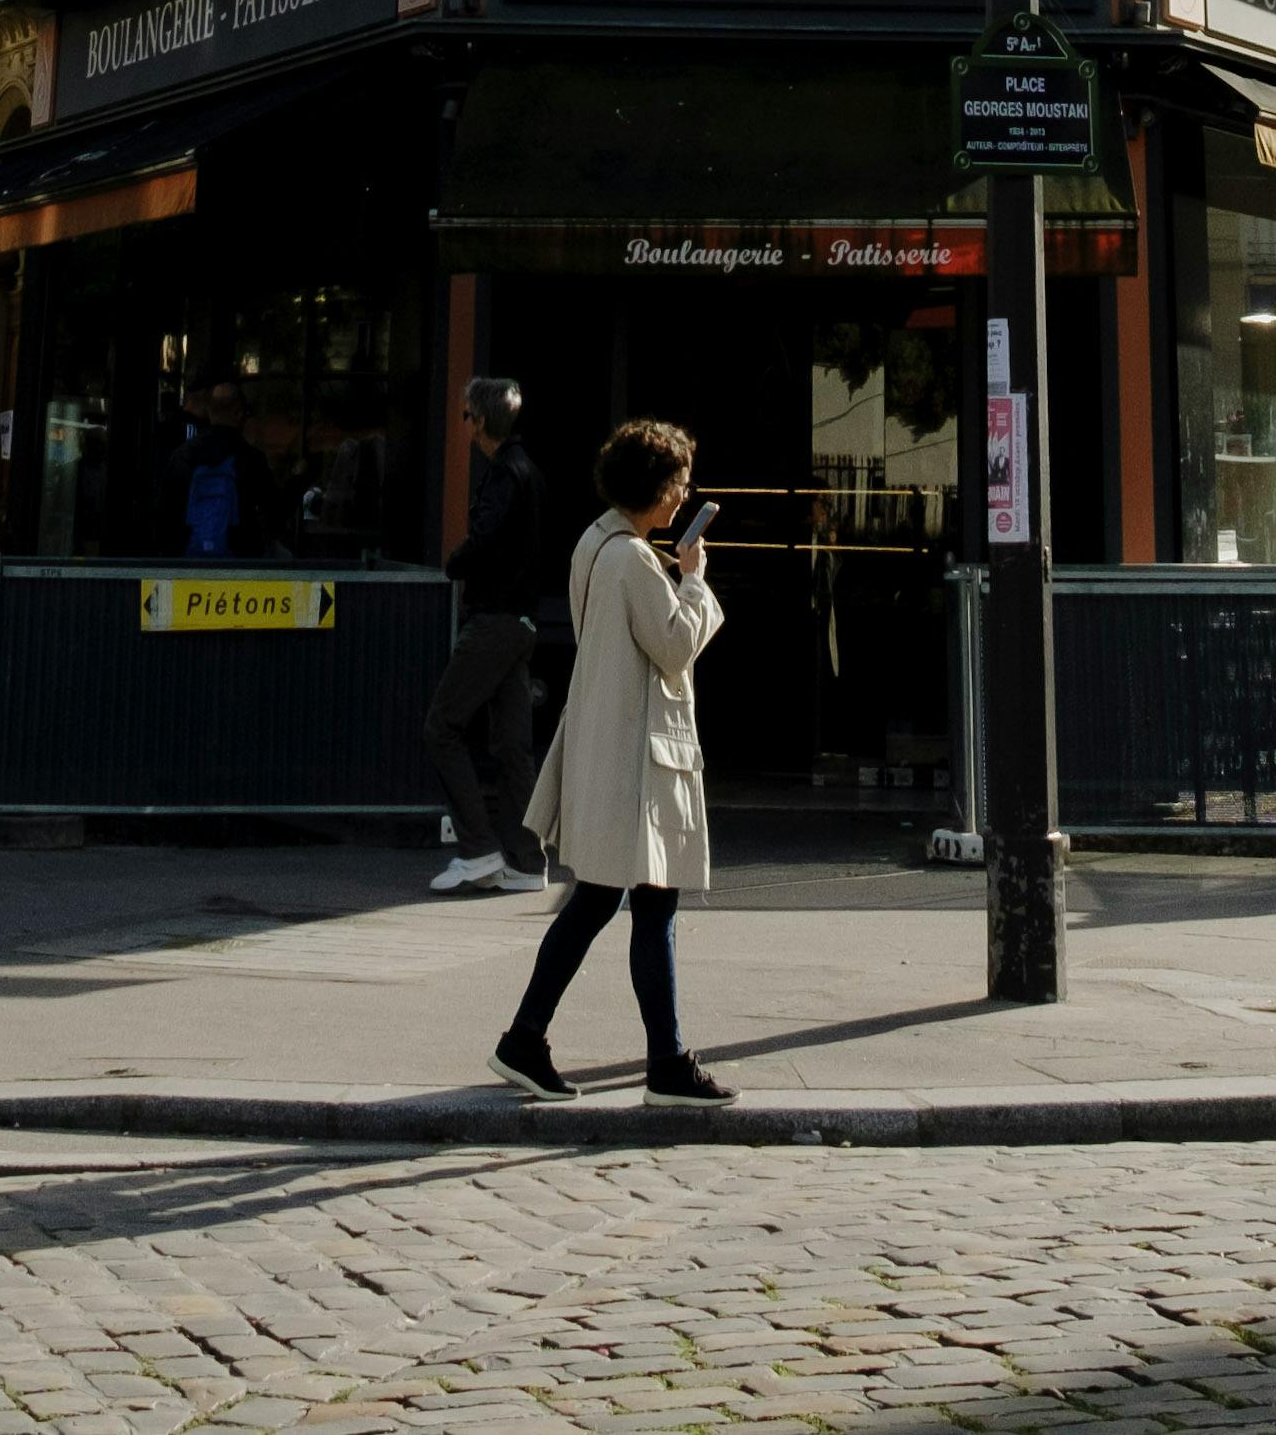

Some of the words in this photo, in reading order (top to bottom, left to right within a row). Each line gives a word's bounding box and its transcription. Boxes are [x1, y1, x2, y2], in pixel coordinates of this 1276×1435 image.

[1005, 76, 1046, 93] PLACE
[964, 100, 1024, 118] GEORGES
[1026, 101, 1088, 119] MOUSTAKI
[625, 238, 784, 273] Boulangerie
[828, 239, 952, 266] Patisserie
[186, 590, 292, 616] Piétons
